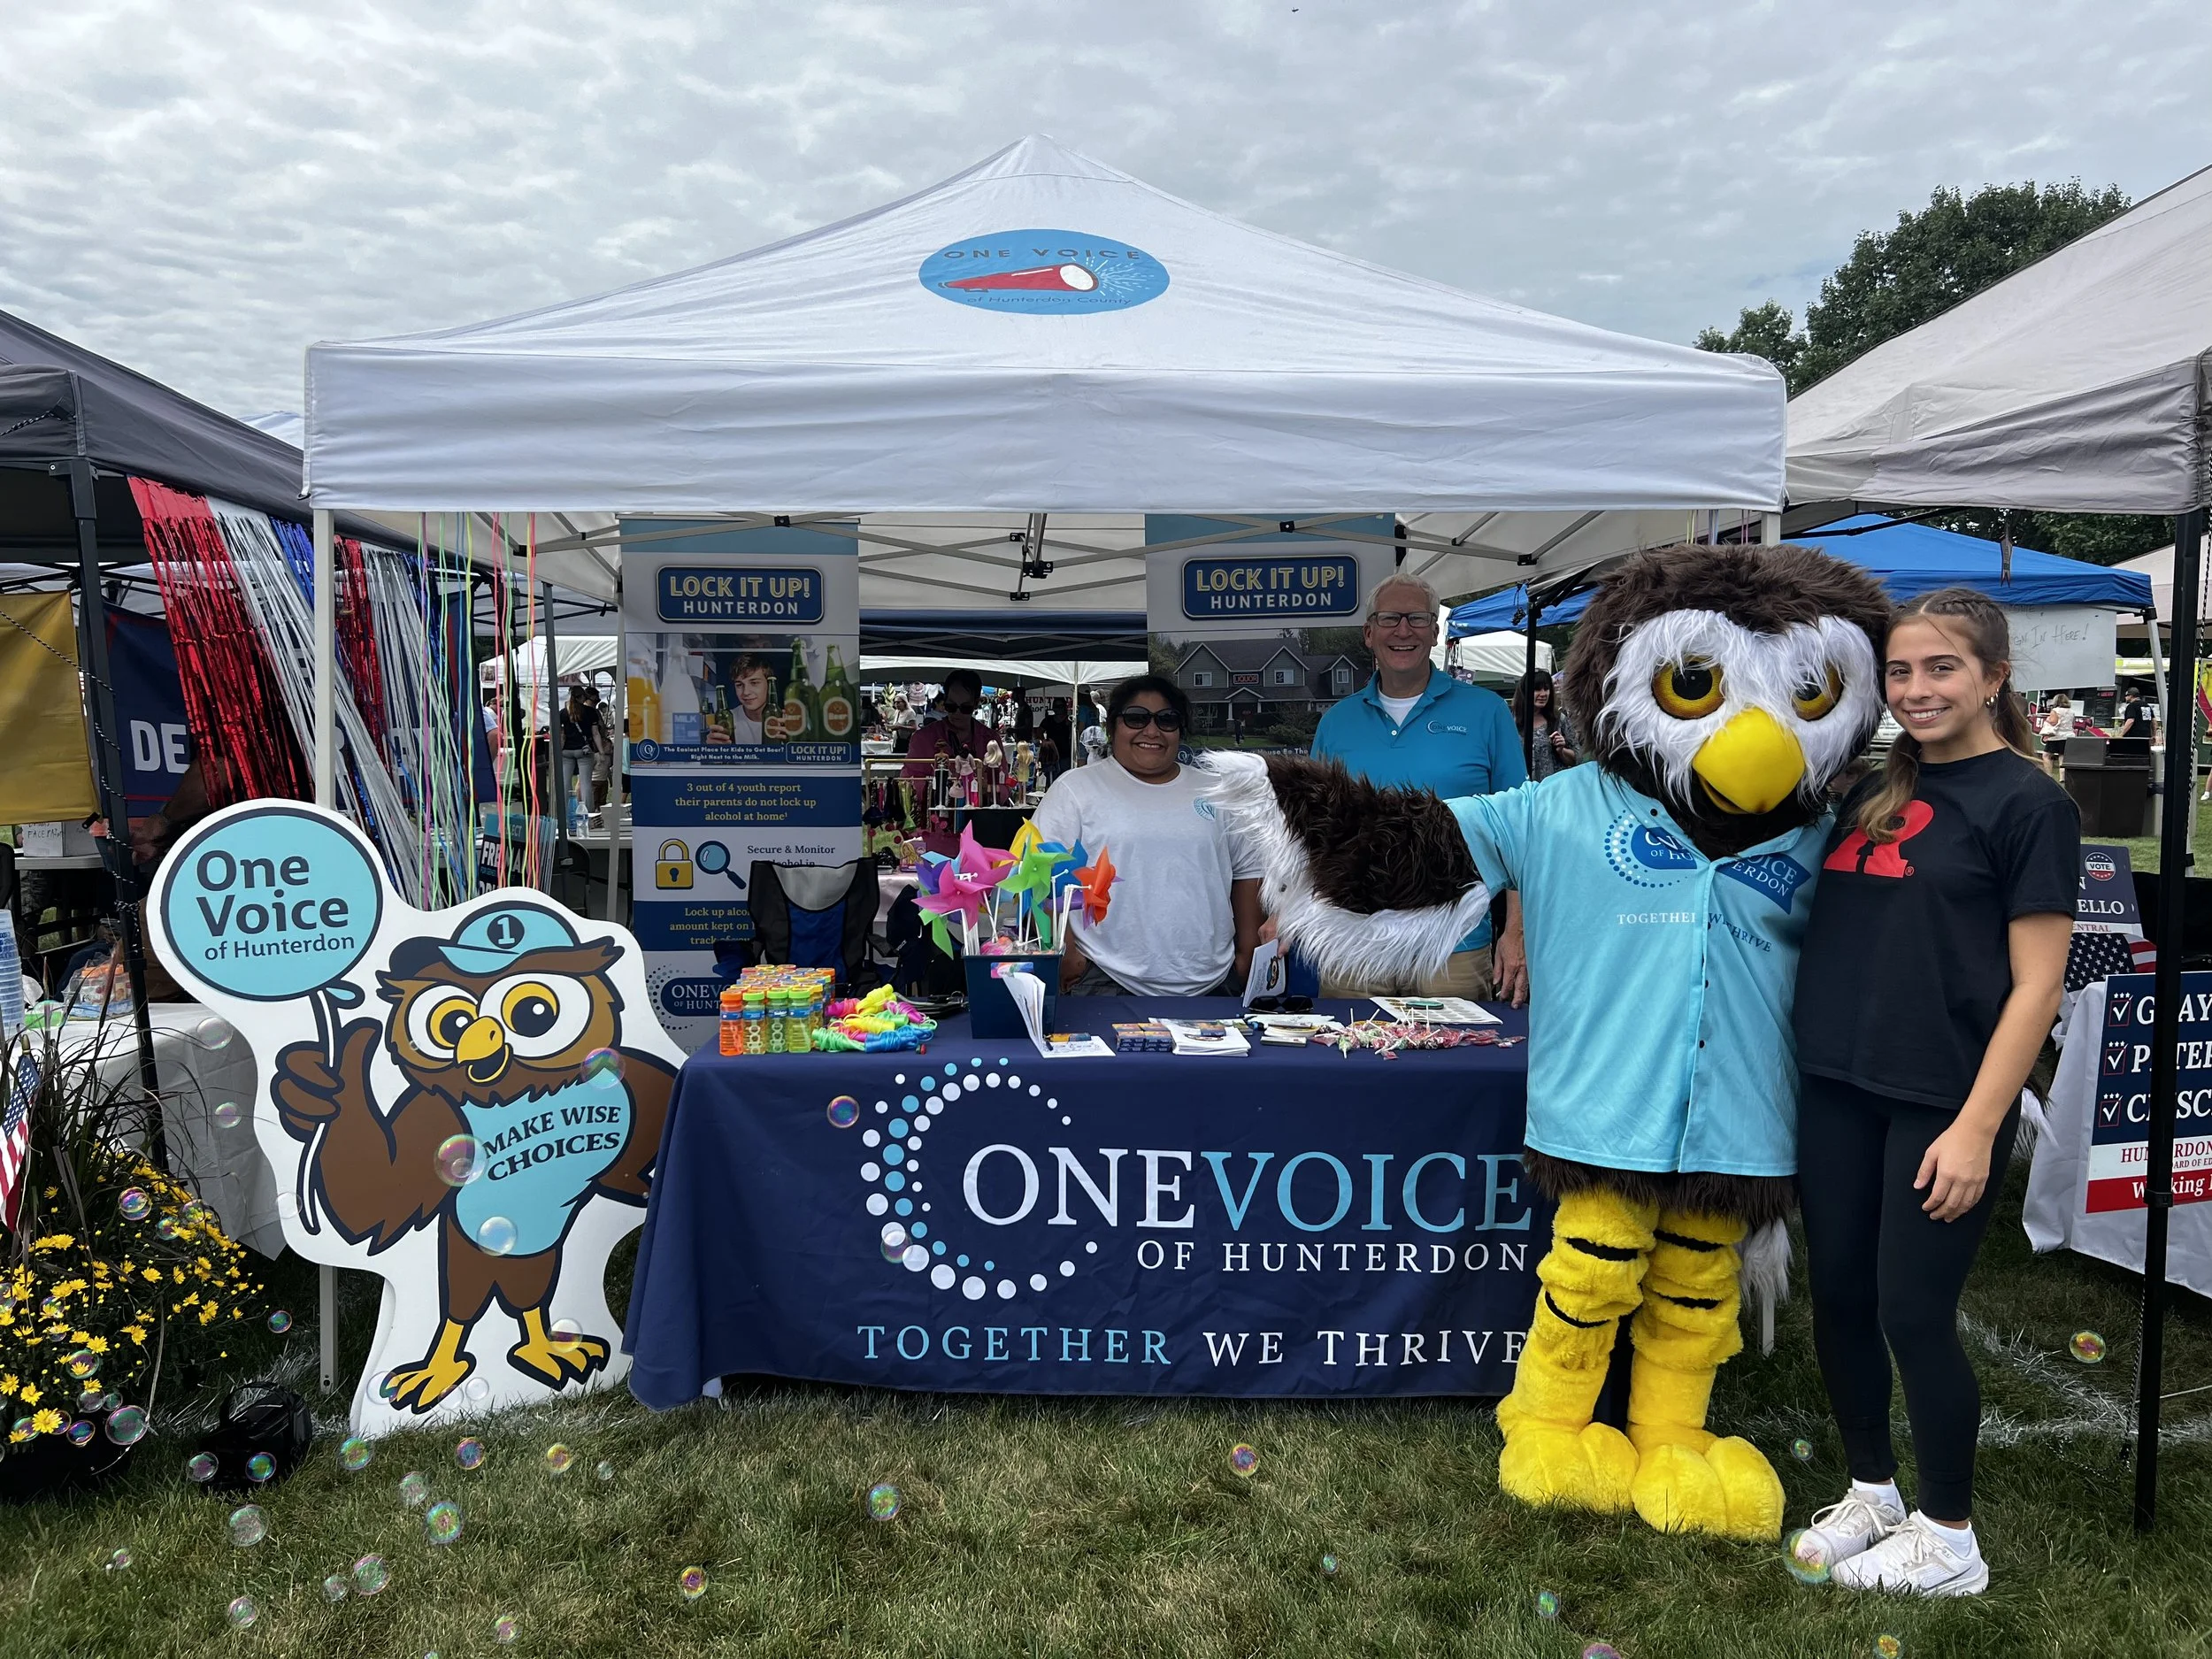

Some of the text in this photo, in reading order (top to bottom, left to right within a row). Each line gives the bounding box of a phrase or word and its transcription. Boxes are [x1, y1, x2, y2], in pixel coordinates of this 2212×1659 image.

[944, 248, 1141, 260] ONE VOICE
[988, 296, 1071, 304] Hunterdon
[1078, 296, 1132, 305] County
[1196, 565, 1345, 592] LOCK IT UP!
[670, 576, 810, 599] LOCK IT UP!
[683, 600, 798, 615] HUNTERDON
[1210, 593, 1332, 610] HUNTERDON
[674, 715, 697, 724] MILK
[130, 719, 191, 774] DE
[791, 746, 846, 755] LOCK IT UP!
[687, 783, 694, 792] 3
[712, 782, 726, 792] of
[728, 783, 734, 792] 4
[736, 782, 767, 795] youth
[769, 783, 802, 795] report
[675, 797, 817, 809] their parents do not lock up
[705, 811, 741, 821] alcohol
[743, 812, 754, 821] at
[747, 845, 835, 855] Secure & Monitor
[196, 849, 310, 892] One
[196, 888, 349, 937] Voice
[685, 907, 750, 918] Lock up alco
[2077, 899, 2124, 915] ELLO
[496, 917, 516, 946] 1
[670, 921, 709, 931] amount
[711, 921, 734, 933] kept
[204, 933, 355, 961] of Hunterdon
[690, 935, 718, 945] track
[687, 1000, 721, 1010] HUNT
[482, 1105, 622, 1158] MAKE WISE
[487, 1132, 621, 1182] CHOICES
[2192, 1158, 2202, 1167] OF
[963, 1144, 1532, 1233] ONEVOICE
[1137, 1240, 1528, 1273] OF HUNTERDON
[856, 1325, 1527, 1368] TOGETHER WE THRIVE
